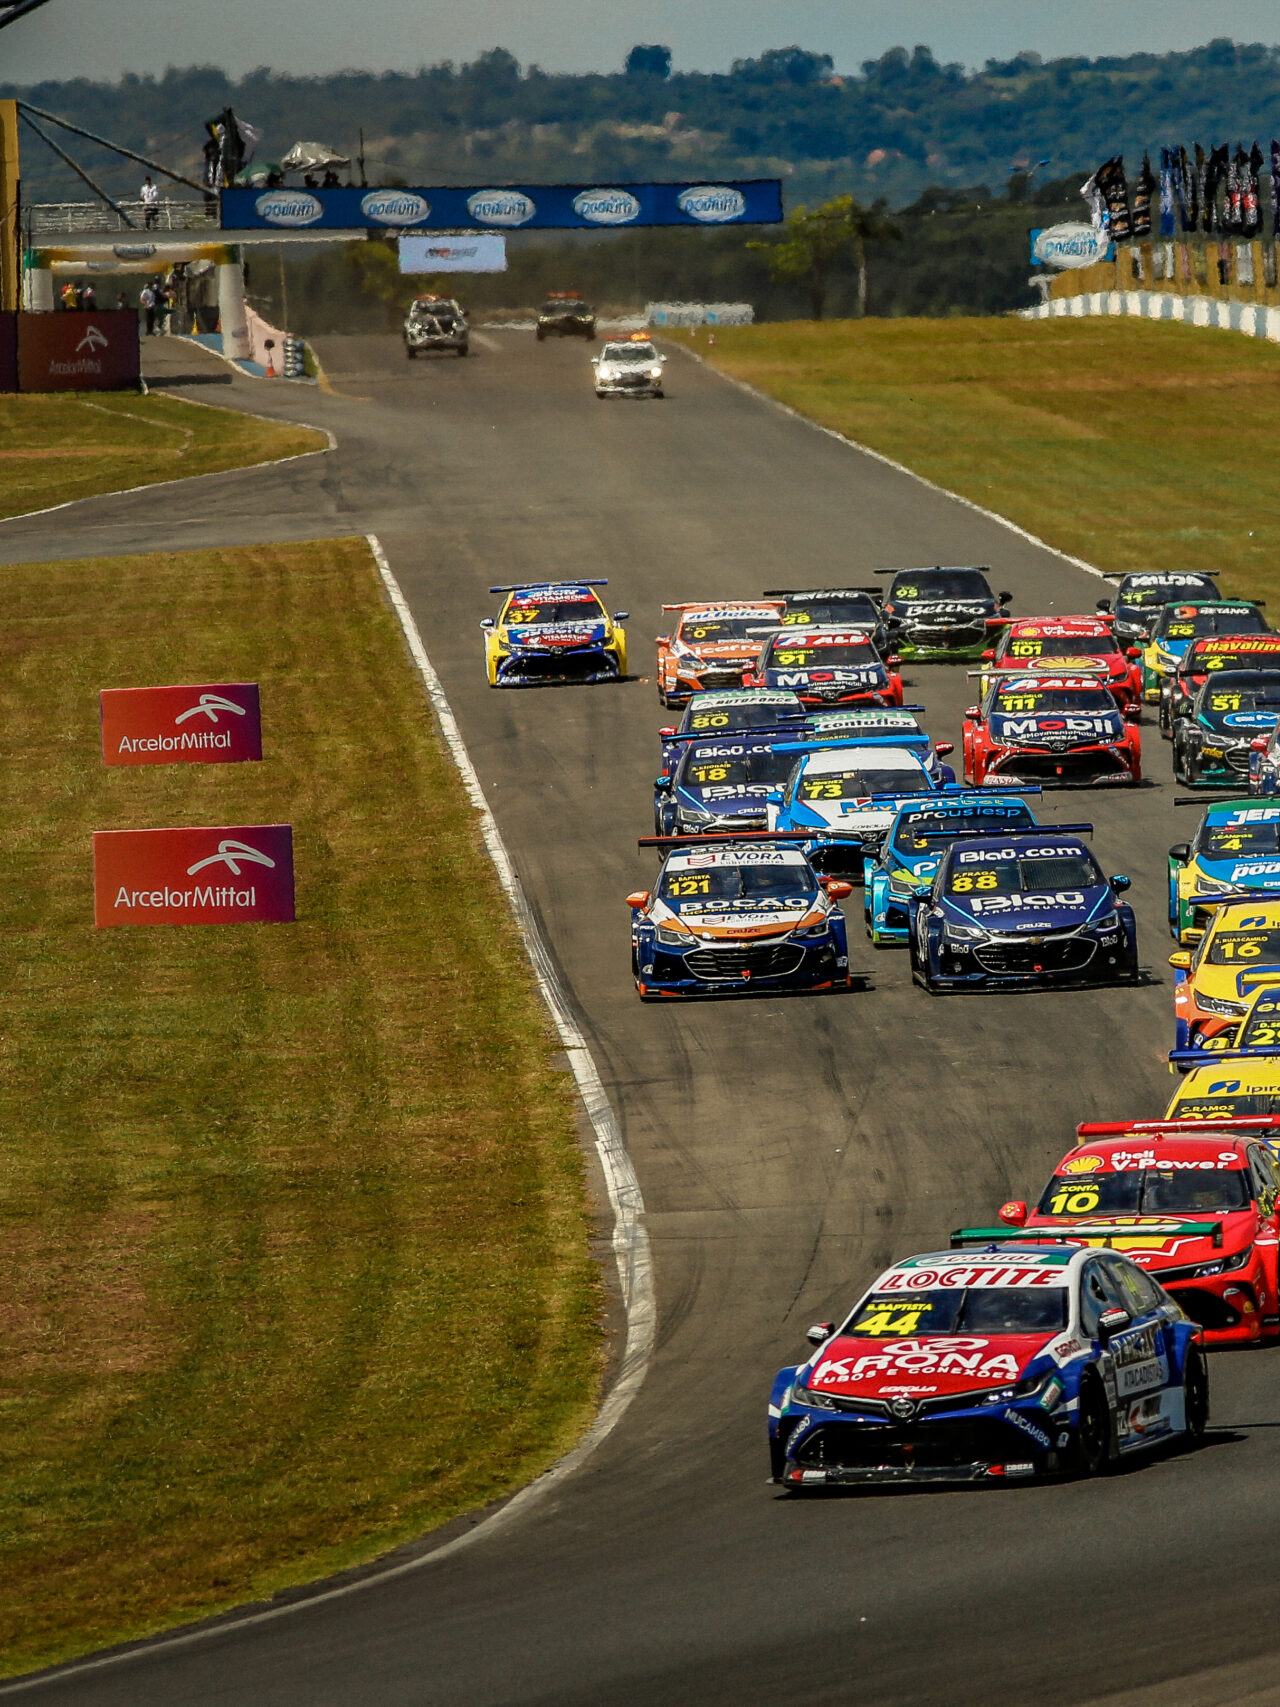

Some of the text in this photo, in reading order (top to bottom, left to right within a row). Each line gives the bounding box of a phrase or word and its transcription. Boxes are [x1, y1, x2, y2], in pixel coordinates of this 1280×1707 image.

[508, 612, 538, 623] 37
[783, 615, 810, 625] 28
[693, 630, 707, 639] 0
[1012, 645, 1041, 655] 101
[778, 655, 806, 665] 91
[1206, 659, 1224, 669] 6
[777, 670, 878, 686] Mobil
[1002, 698, 1036, 711] 111
[1212, 699, 1240, 711] 51
[692, 717, 729, 728] 80
[1003, 718, 1113, 736] Mobil
[118, 730, 231, 754] ArcelorMittal
[696, 769, 728, 782] 18
[804, 784, 843, 799] 73
[1219, 839, 1242, 850] 4
[720, 853, 785, 861] EVORA
[668, 880, 710, 896] 121
[952, 875, 999, 893] 88
[113, 886, 256, 908] ArcelorMittal
[1016, 922, 1052, 930] CRUZE
[1220, 941, 1262, 959] 16
[1180, 1104, 1236, 1113] C.RAMOS
[1111, 1149, 1155, 1162] Shell
[1111, 1158, 1231, 1171] V-Power
[1058, 1184, 1100, 1193] ZONTA
[1050, 1191, 1100, 1215] 10
[878, 1267, 1064, 1291] LOCTITE
[853, 1311, 922, 1336] 44
[816, 1351, 1020, 1380] KRONA
[812, 1369, 875, 1386] TUBOS
[908, 1365, 1018, 1381] CONEXÕES
